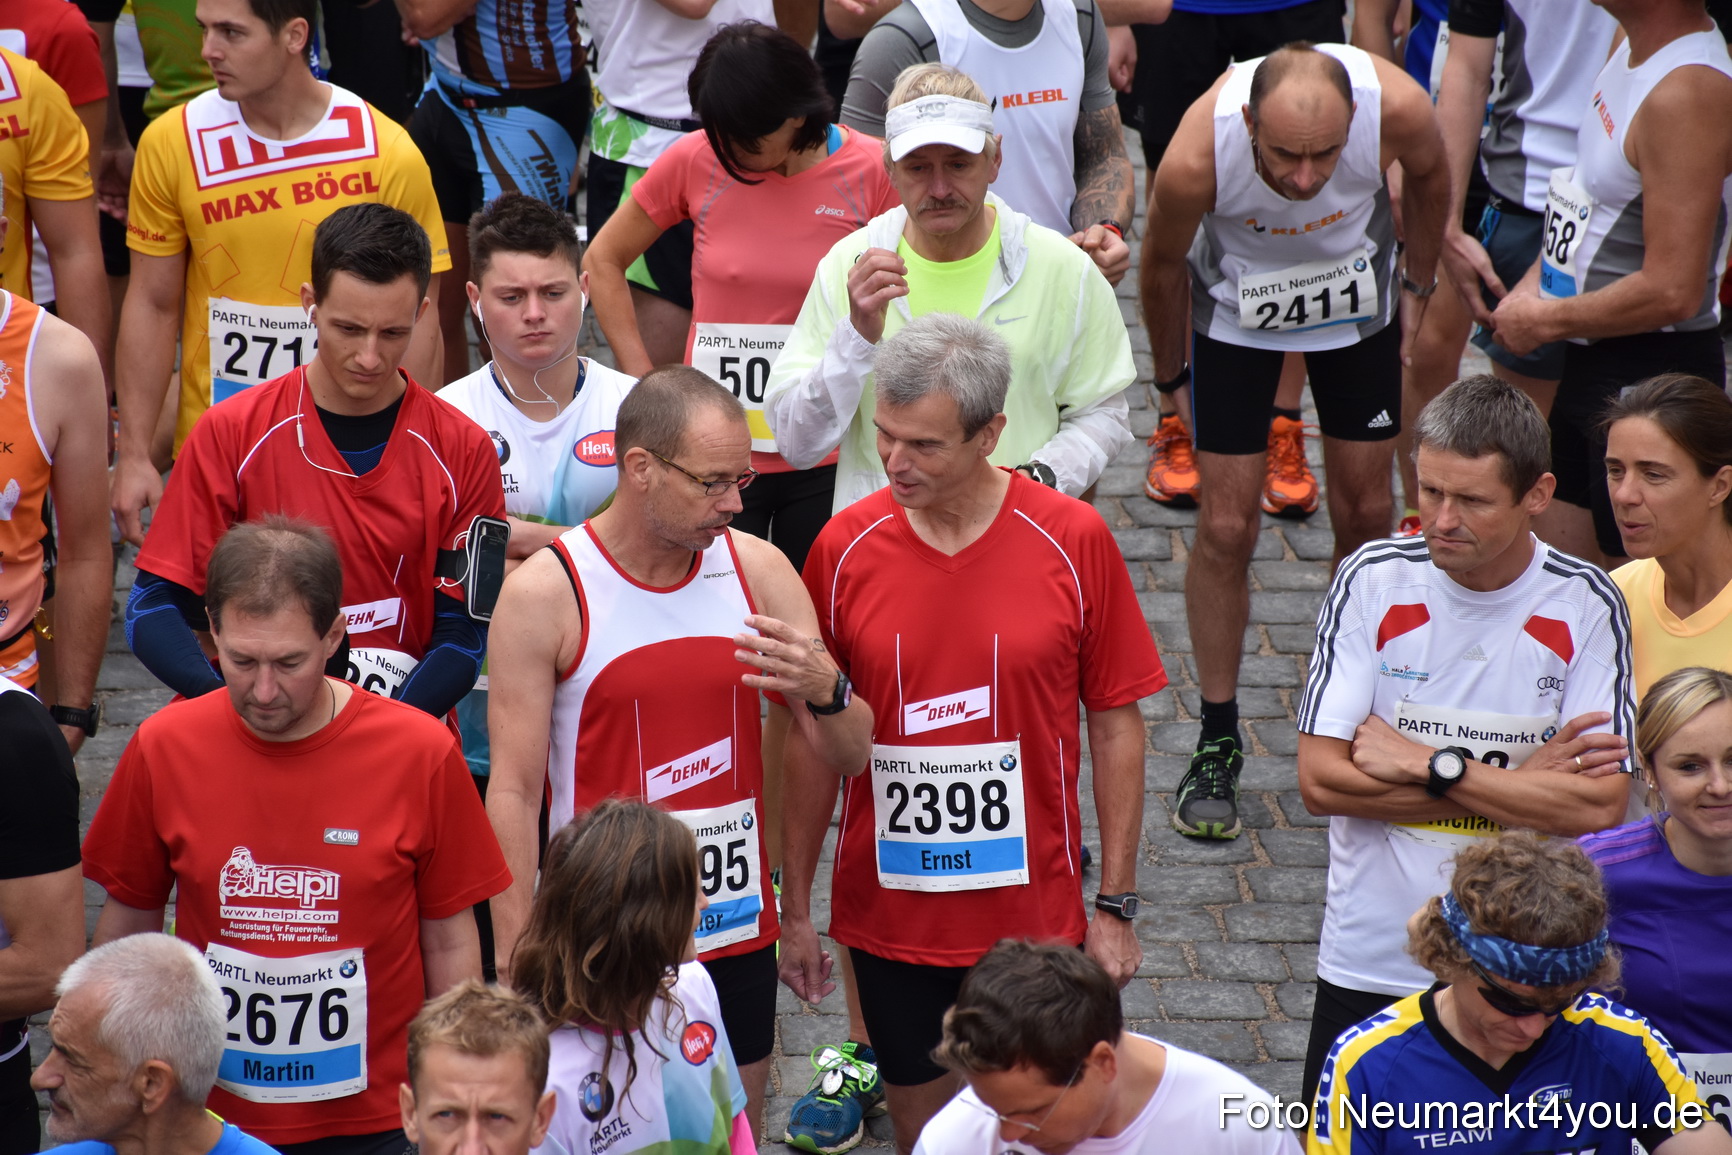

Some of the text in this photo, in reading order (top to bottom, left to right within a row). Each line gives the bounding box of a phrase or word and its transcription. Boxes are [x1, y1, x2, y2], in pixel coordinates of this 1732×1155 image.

[1002, 88, 1068, 108] KLEBL
[1598, 101, 1615, 140] KLEBL
[200, 171, 379, 225] MAX BÖGL
[1548, 186, 1578, 213] Neumarkt
[825, 207, 844, 216] asics
[1271, 210, 1349, 235] KLEBL
[1241, 265, 1350, 299] PARTL Neumarkt
[1256, 280, 1359, 329] 2411
[212, 310, 256, 328] PARTL
[697, 336, 785, 350] PARTL Neuma
[224, 332, 318, 379] 271
[1368, 420, 1392, 428] adidas
[501, 474, 518, 484] TL
[704, 570, 735, 579] BROOKS
[347, 610, 375, 626] EHN
[927, 700, 966, 722] DEHN
[1398, 717, 1536, 744] PARTL Neumarkt
[671, 757, 710, 785] DEHN
[874, 759, 993, 774] PARTL Neumarkt
[886, 779, 1010, 835] 2398
[337, 832, 358, 841] RONO
[921, 850, 972, 870] Ernst
[253, 871, 334, 906] Helpi
[222, 909, 336, 922] www.helpi.com
[220, 929, 338, 942] Rettungsdienst, THW und Polizei
[229, 921, 327, 934] Ausrüstung für Feuerwehr,
[208, 959, 333, 986] PARTL Neumarkt
[220, 987, 349, 1046] 2676
[243, 1059, 314, 1082] Martin
[1413, 1128, 1492, 1149] TEAM
